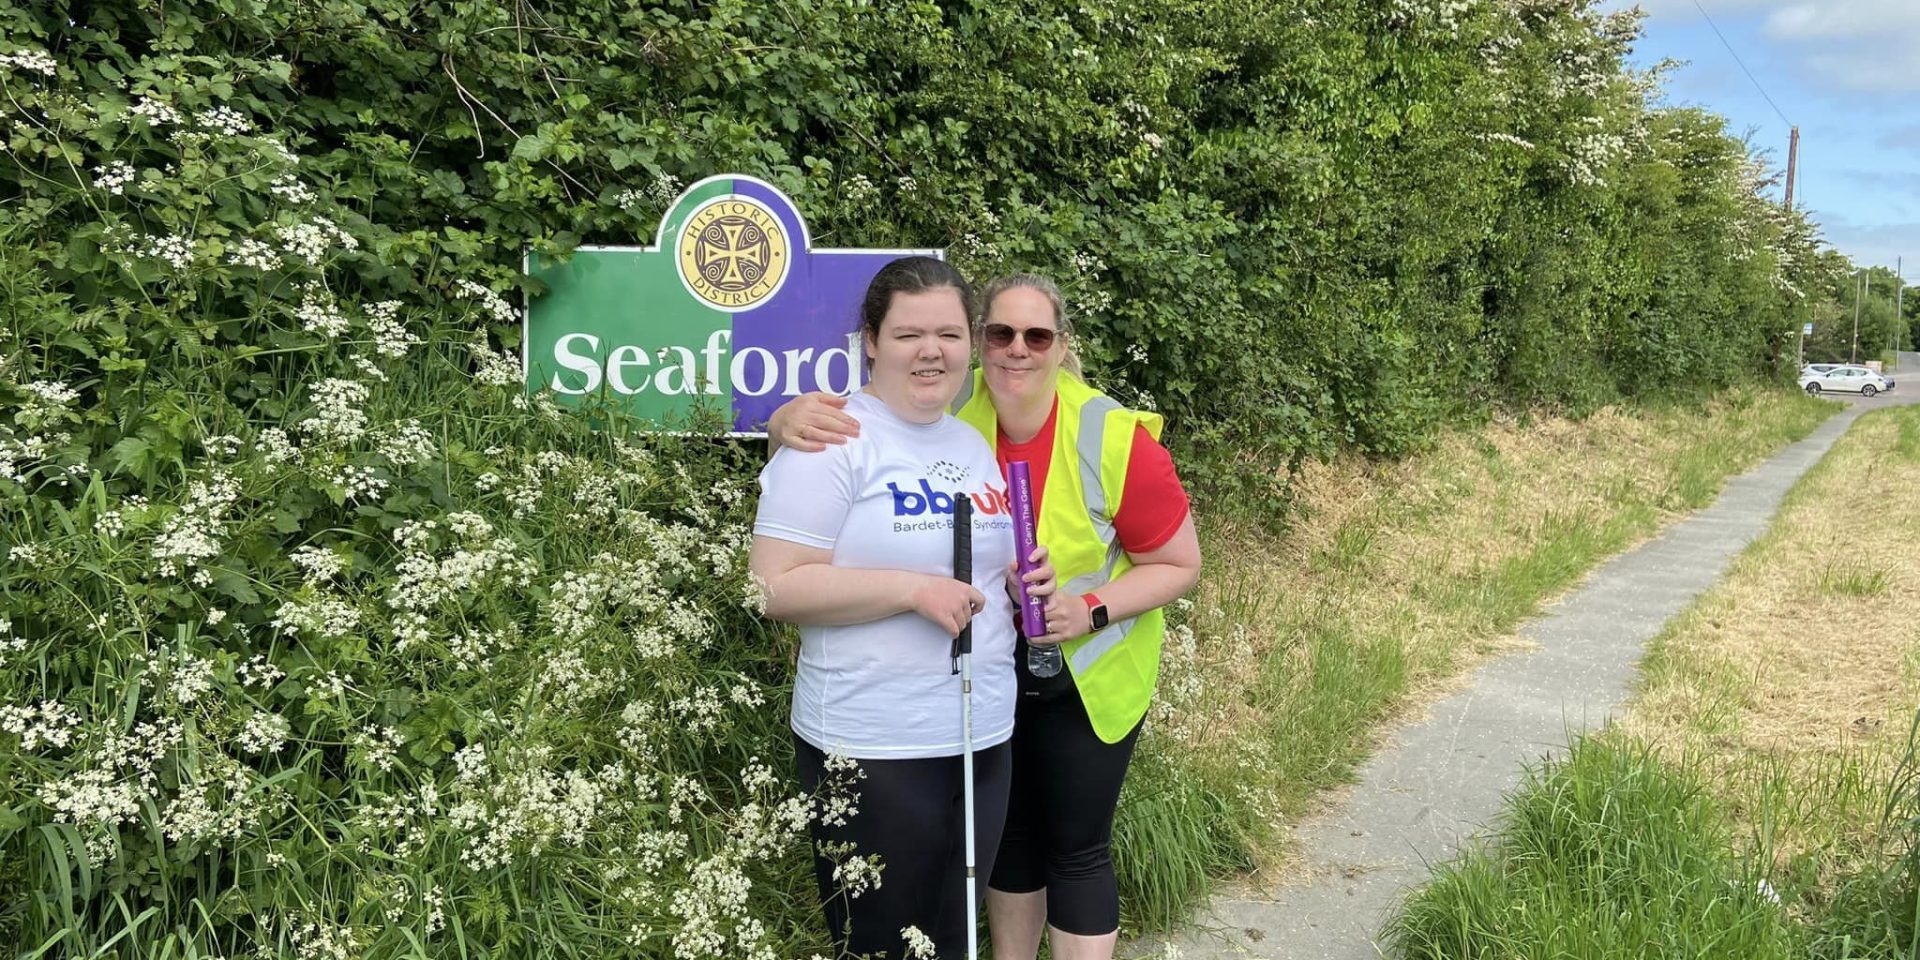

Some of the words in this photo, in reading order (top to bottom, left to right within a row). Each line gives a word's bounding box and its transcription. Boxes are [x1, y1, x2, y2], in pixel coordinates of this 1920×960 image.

[687, 203, 779, 239] HISTORIC
[693, 277, 771, 304] DISTRICT
[551, 329, 862, 398] Seaford
[1022, 503, 1030, 520] The
